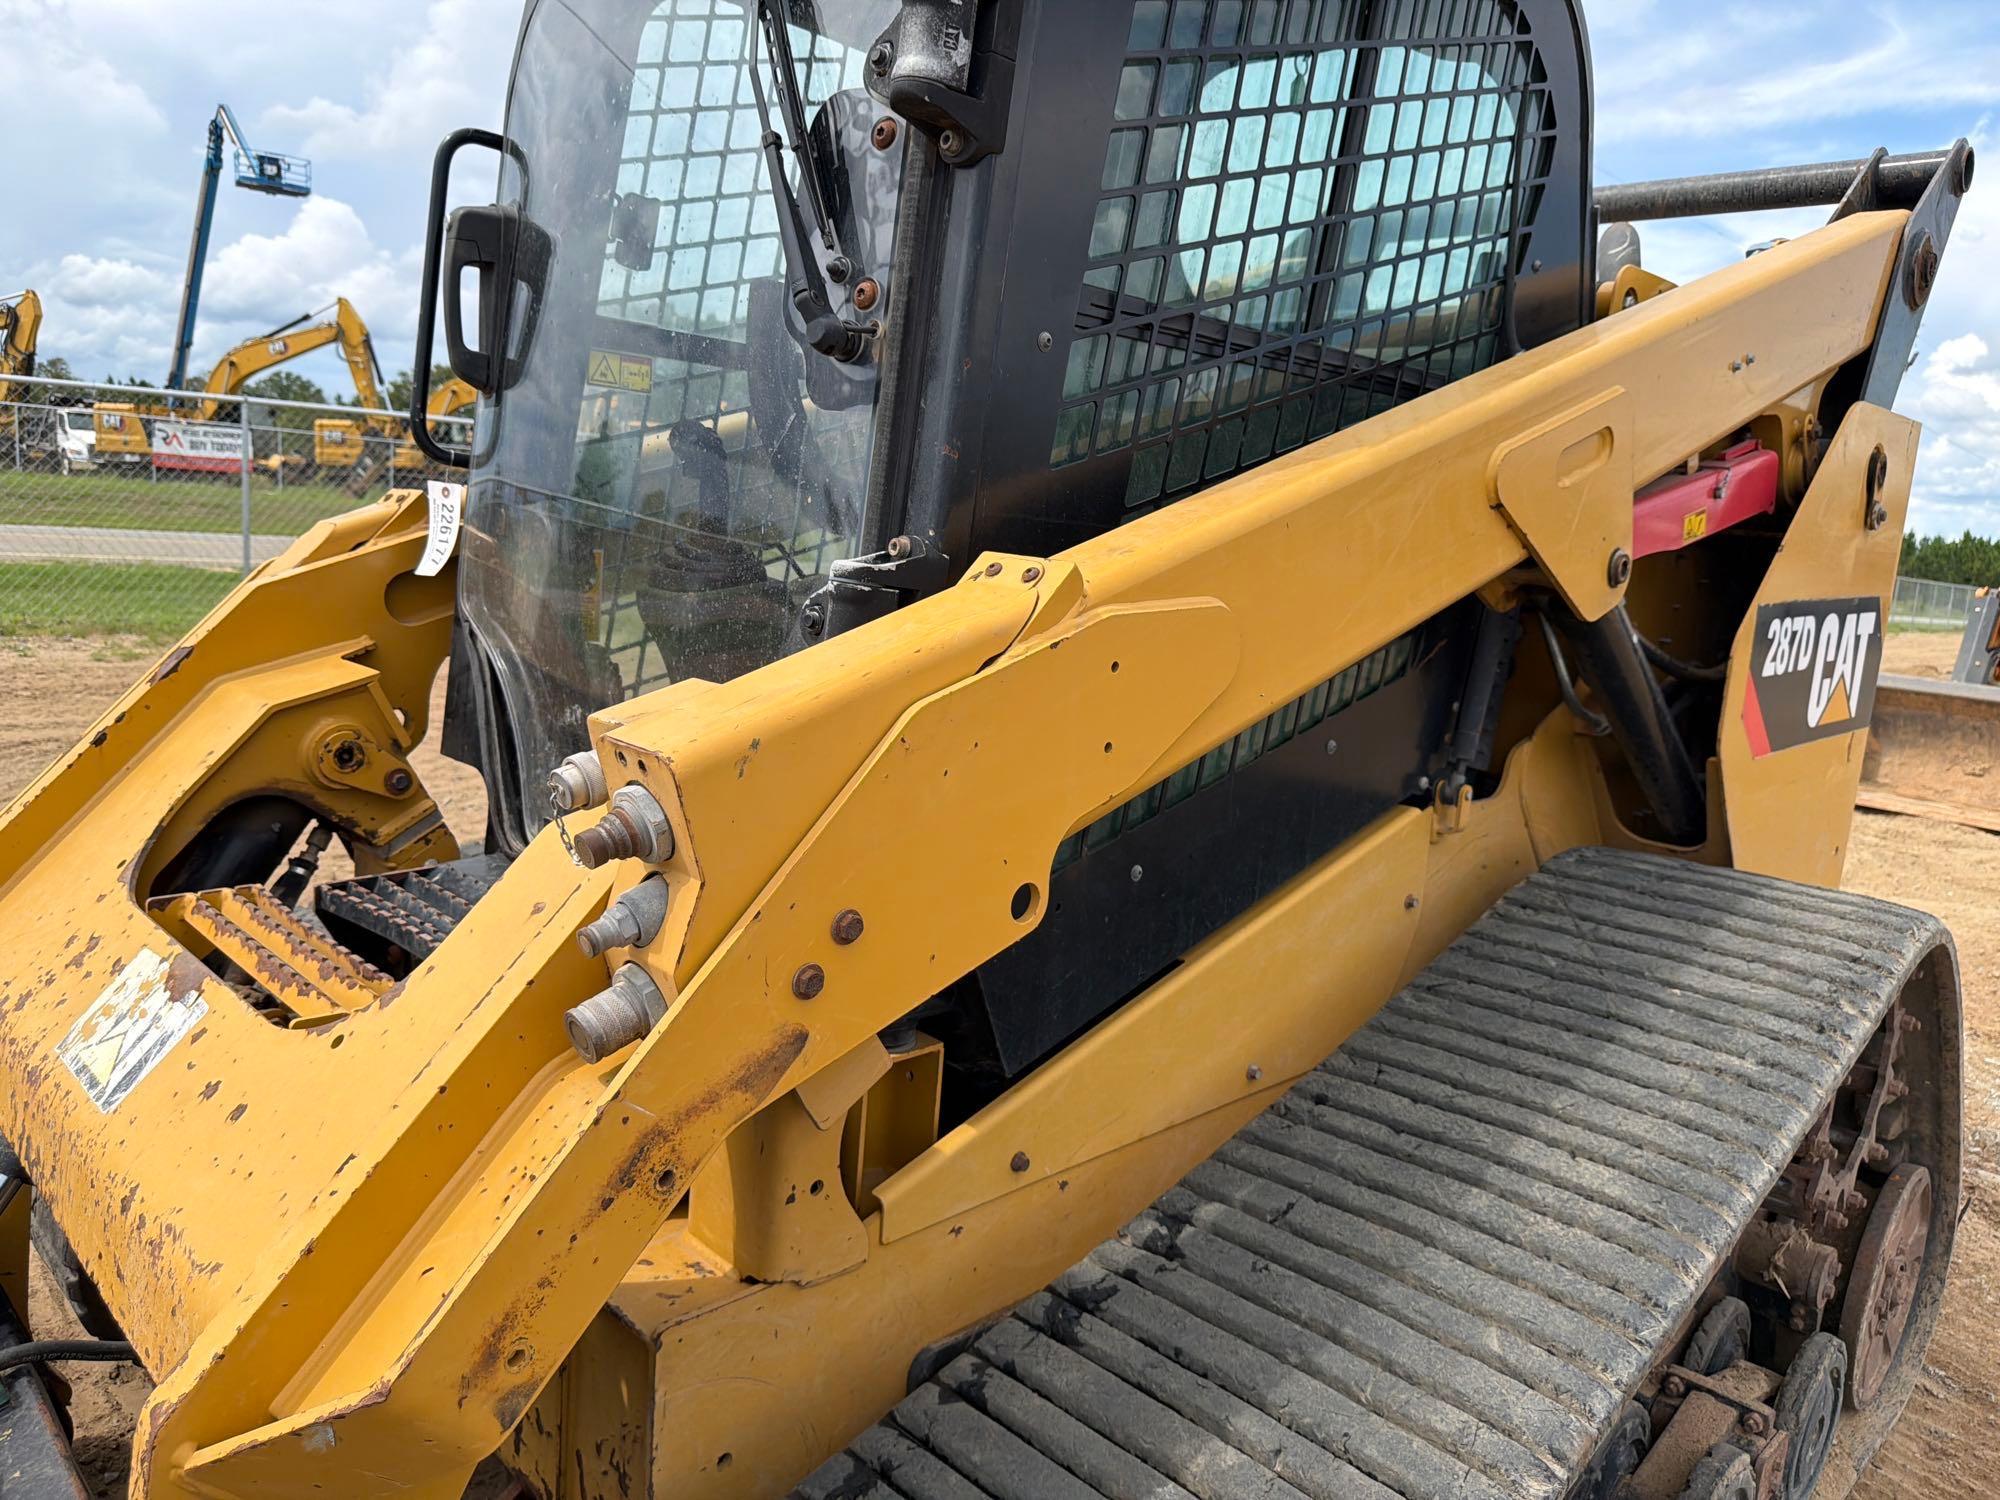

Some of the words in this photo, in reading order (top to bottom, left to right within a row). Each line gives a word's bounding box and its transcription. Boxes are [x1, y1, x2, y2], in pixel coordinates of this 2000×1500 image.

[943, 22, 961, 51] CAT
[431, 503, 454, 565] 226177
[1761, 615, 1816, 677] 287D
[1807, 612, 1877, 728] CAT
